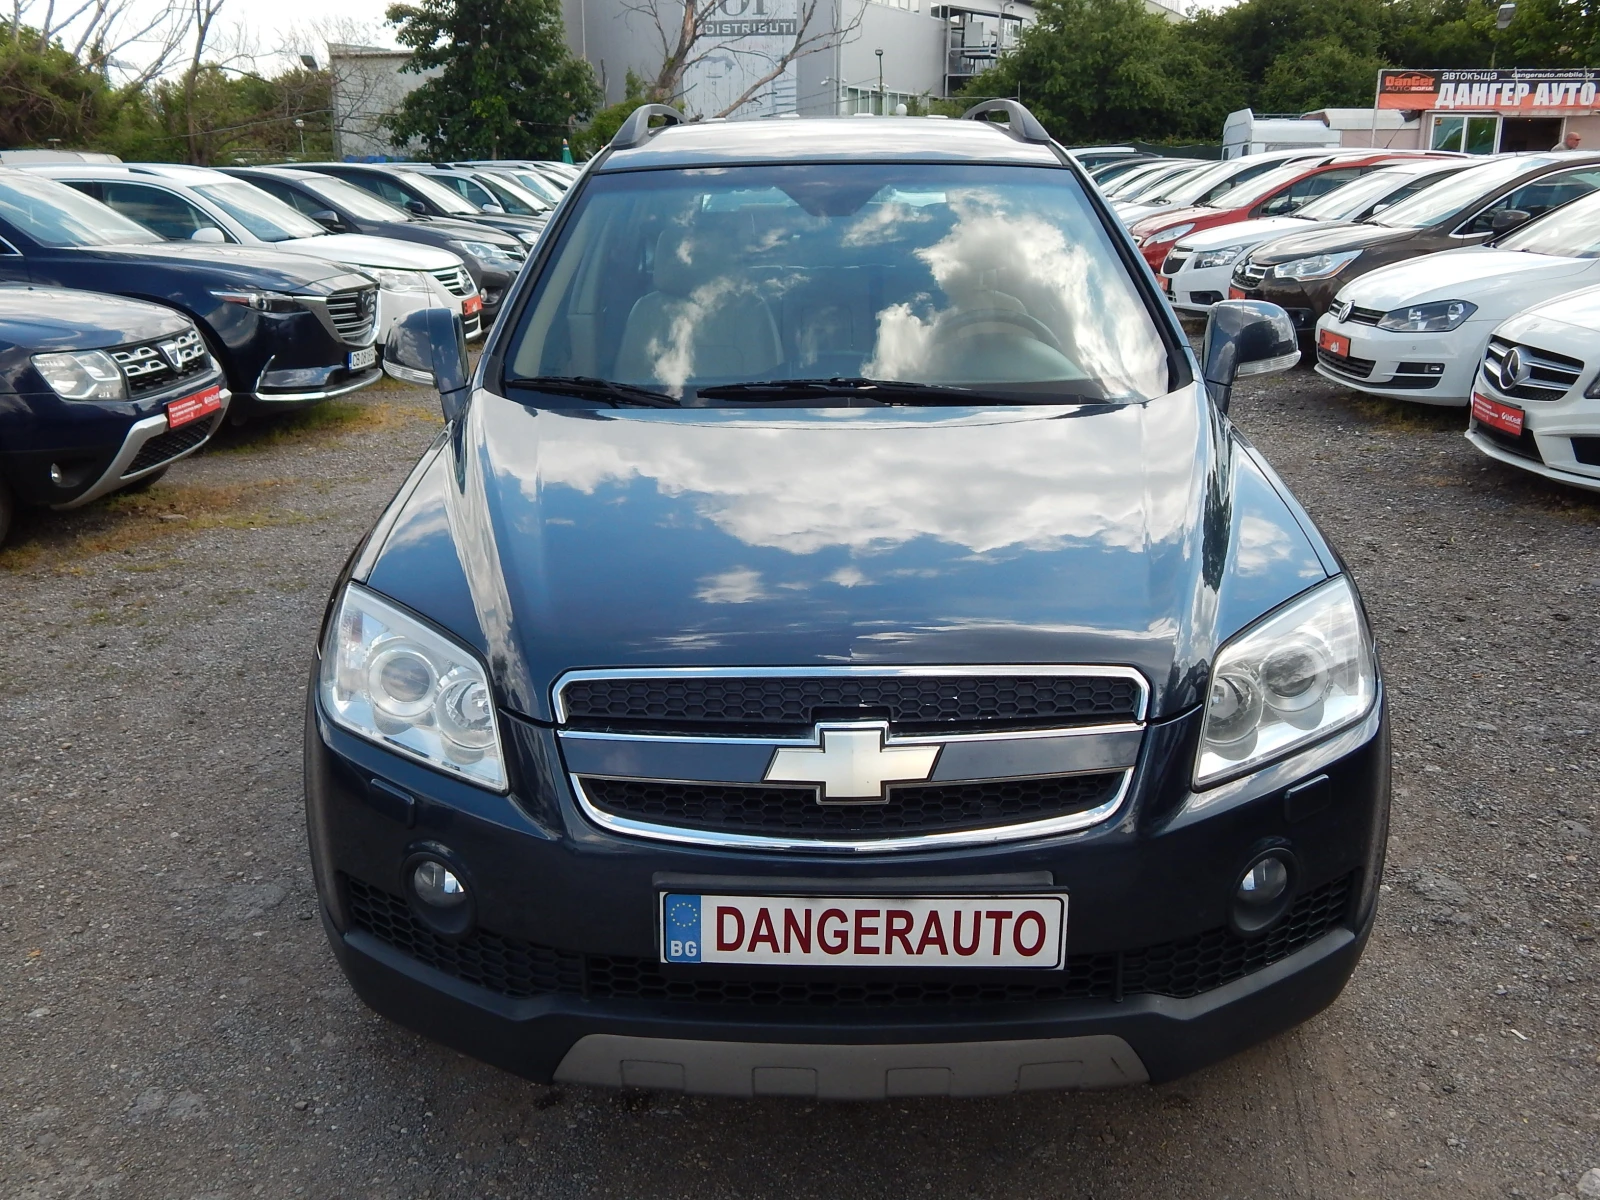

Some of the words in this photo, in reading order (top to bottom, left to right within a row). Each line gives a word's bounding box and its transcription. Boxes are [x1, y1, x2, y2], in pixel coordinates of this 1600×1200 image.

[1441, 72, 1498, 81] автокъща
[1434, 82, 1530, 109] ДАНГЕР
[1532, 82, 1596, 106] АУТО
[716, 905, 1047, 957] DANGERAUTO
[670, 940, 697, 957] BG
